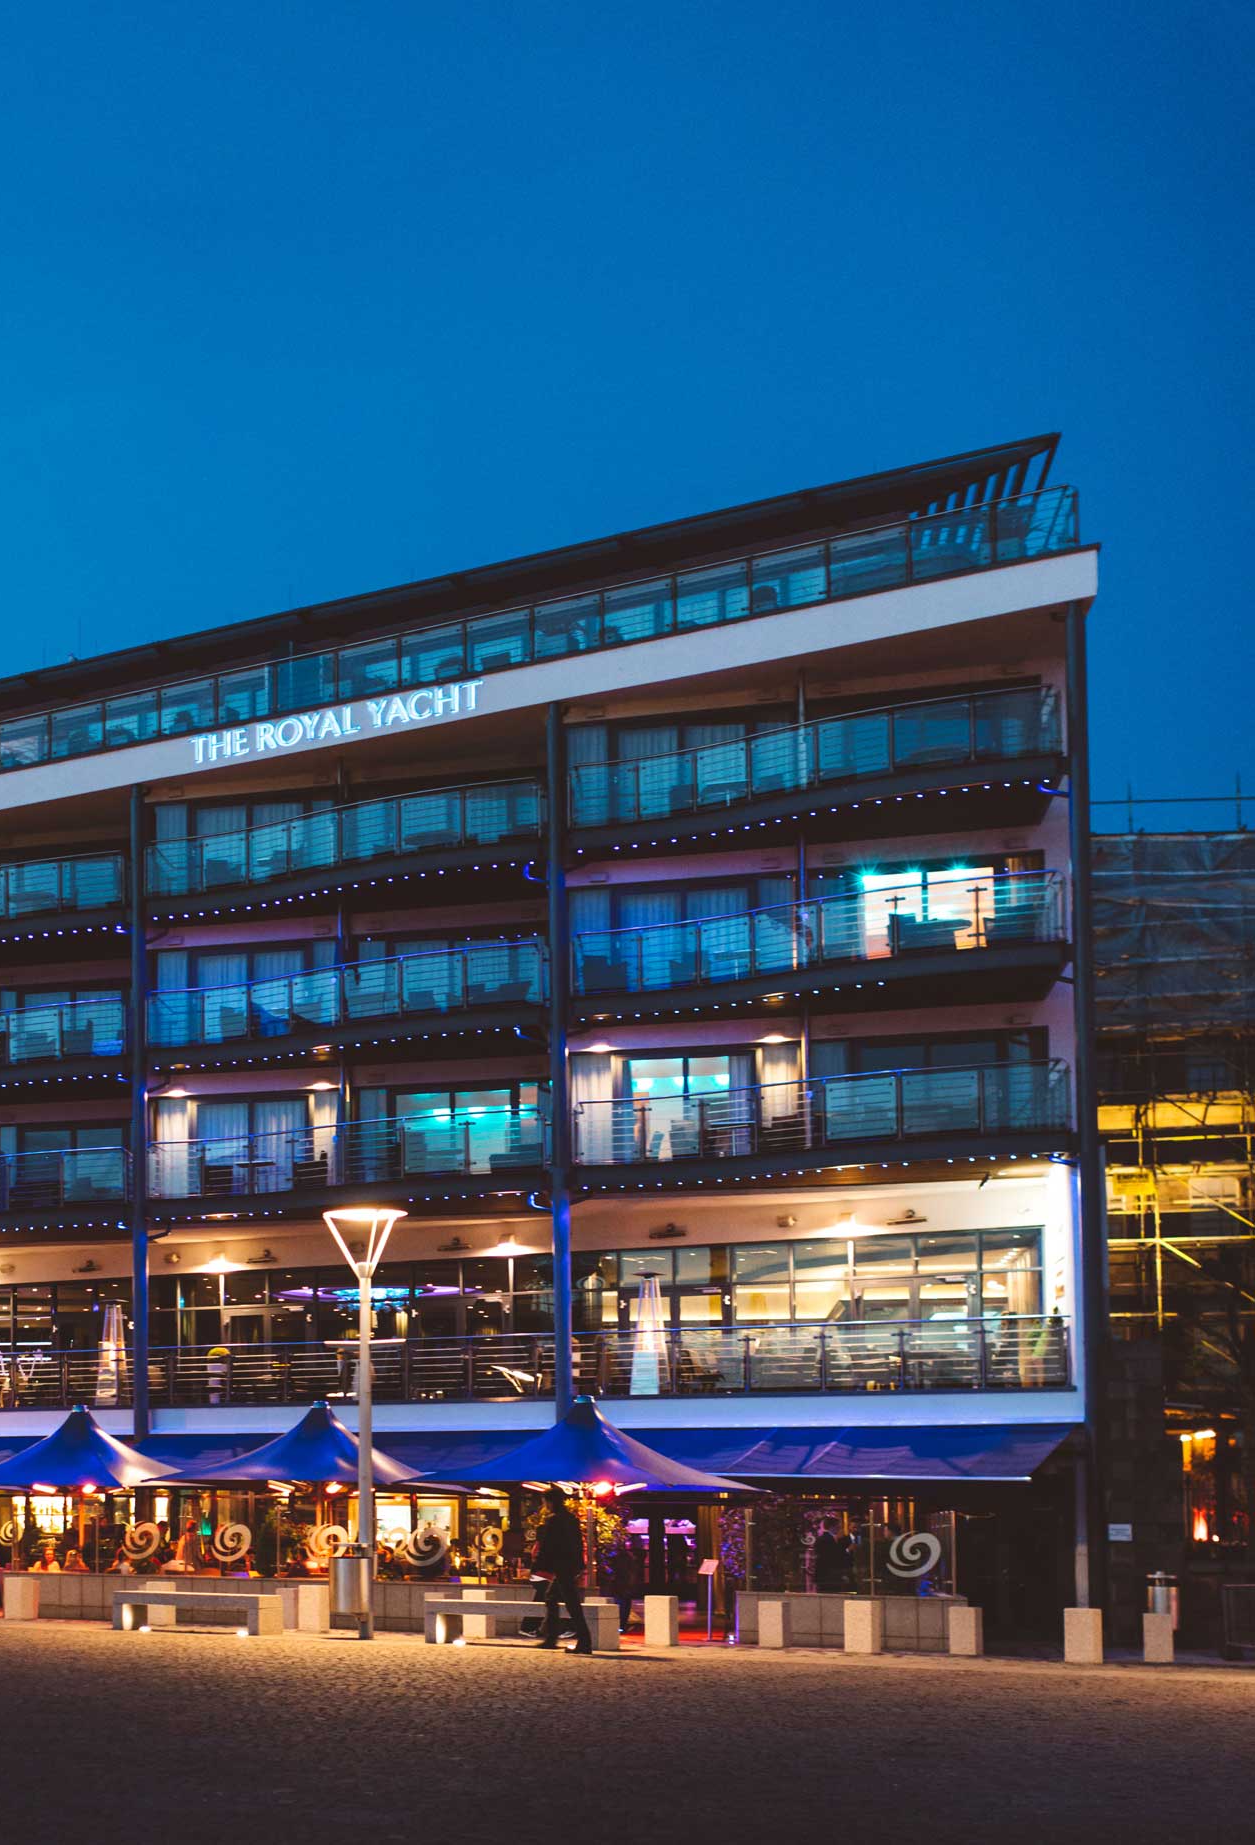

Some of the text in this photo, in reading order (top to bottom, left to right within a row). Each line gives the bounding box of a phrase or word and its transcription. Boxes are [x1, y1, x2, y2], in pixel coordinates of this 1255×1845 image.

[188, 679, 483, 764] THE ROYAL YACHT
